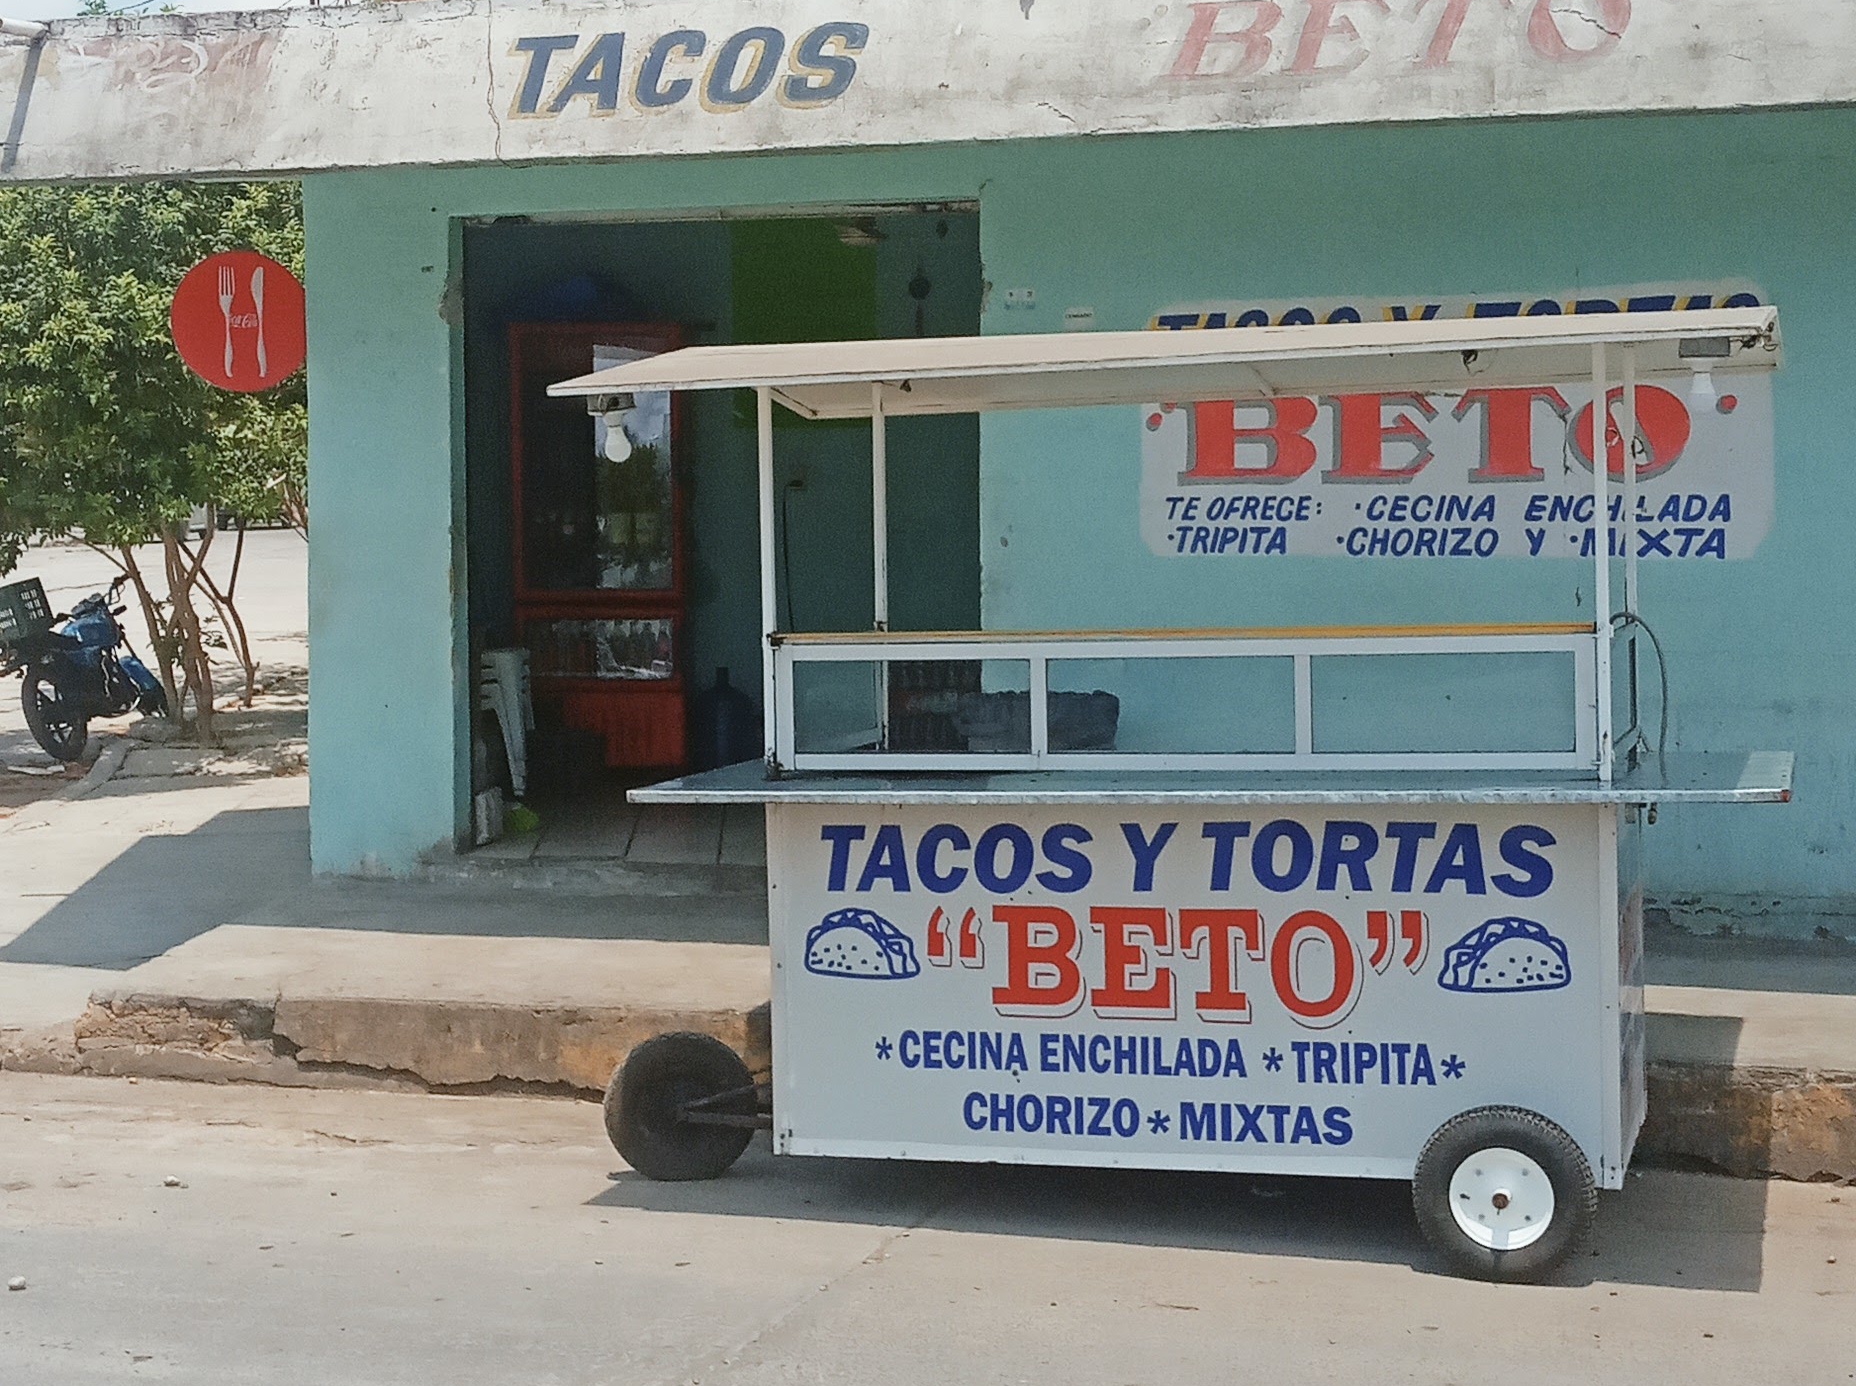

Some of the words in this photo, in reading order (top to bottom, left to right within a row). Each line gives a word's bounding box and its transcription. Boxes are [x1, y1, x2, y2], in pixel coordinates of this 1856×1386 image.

[509, 21, 870, 121] TACOS
[1165, 495, 1201, 521] TE
[1205, 494, 1322, 522] OFRECE:
[1524, 493, 1732, 523] ENCHLADA
[1525, 527, 1546, 557] Y
[820, 821, 1094, 894] TACOS
[1119, 821, 1180, 892] Y
[1201, 819, 1558, 898] TORTAS
[925, 904, 1431, 1029] “BETO”
[1038, 1033, 1248, 1079] ENCHILADA
[962, 1091, 1141, 1139] CHORIZO
[1178, 1101, 1354, 1147] MIXTAS
